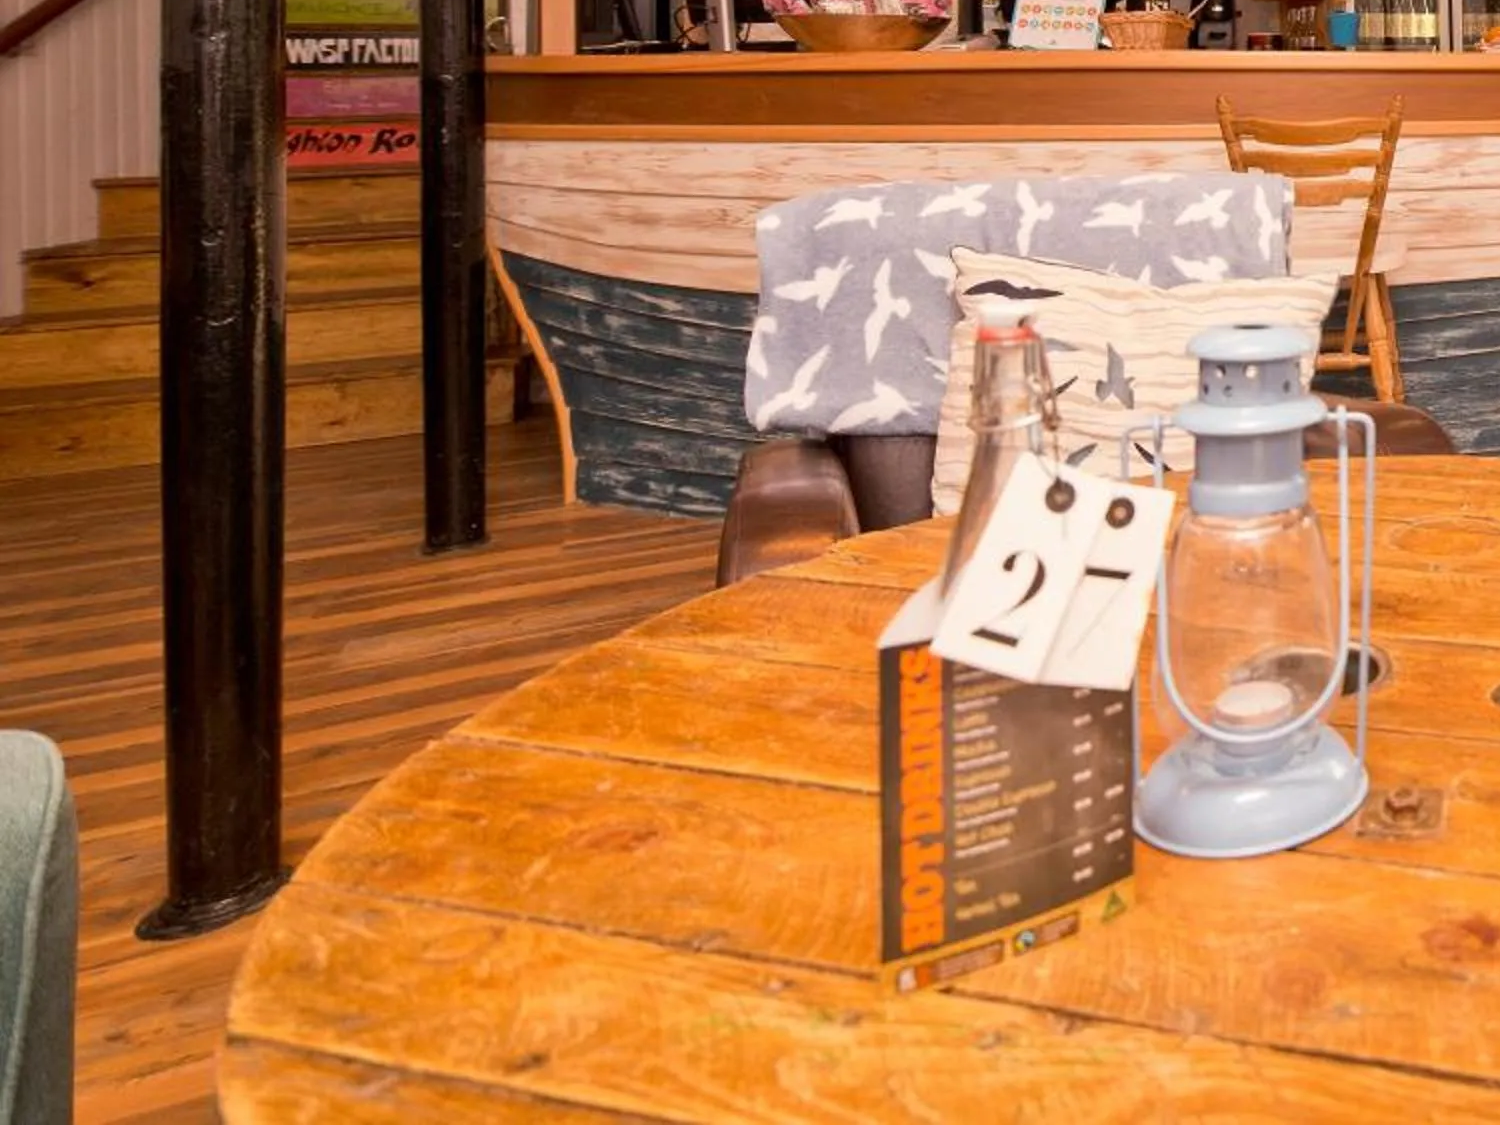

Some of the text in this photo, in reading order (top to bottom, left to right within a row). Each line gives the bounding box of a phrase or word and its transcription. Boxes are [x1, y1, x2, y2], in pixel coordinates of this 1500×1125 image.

[285, 38, 349, 64] WASP
[367, 127, 417, 154] Ro
[900, 648, 945, 953] HOT DRINKS
